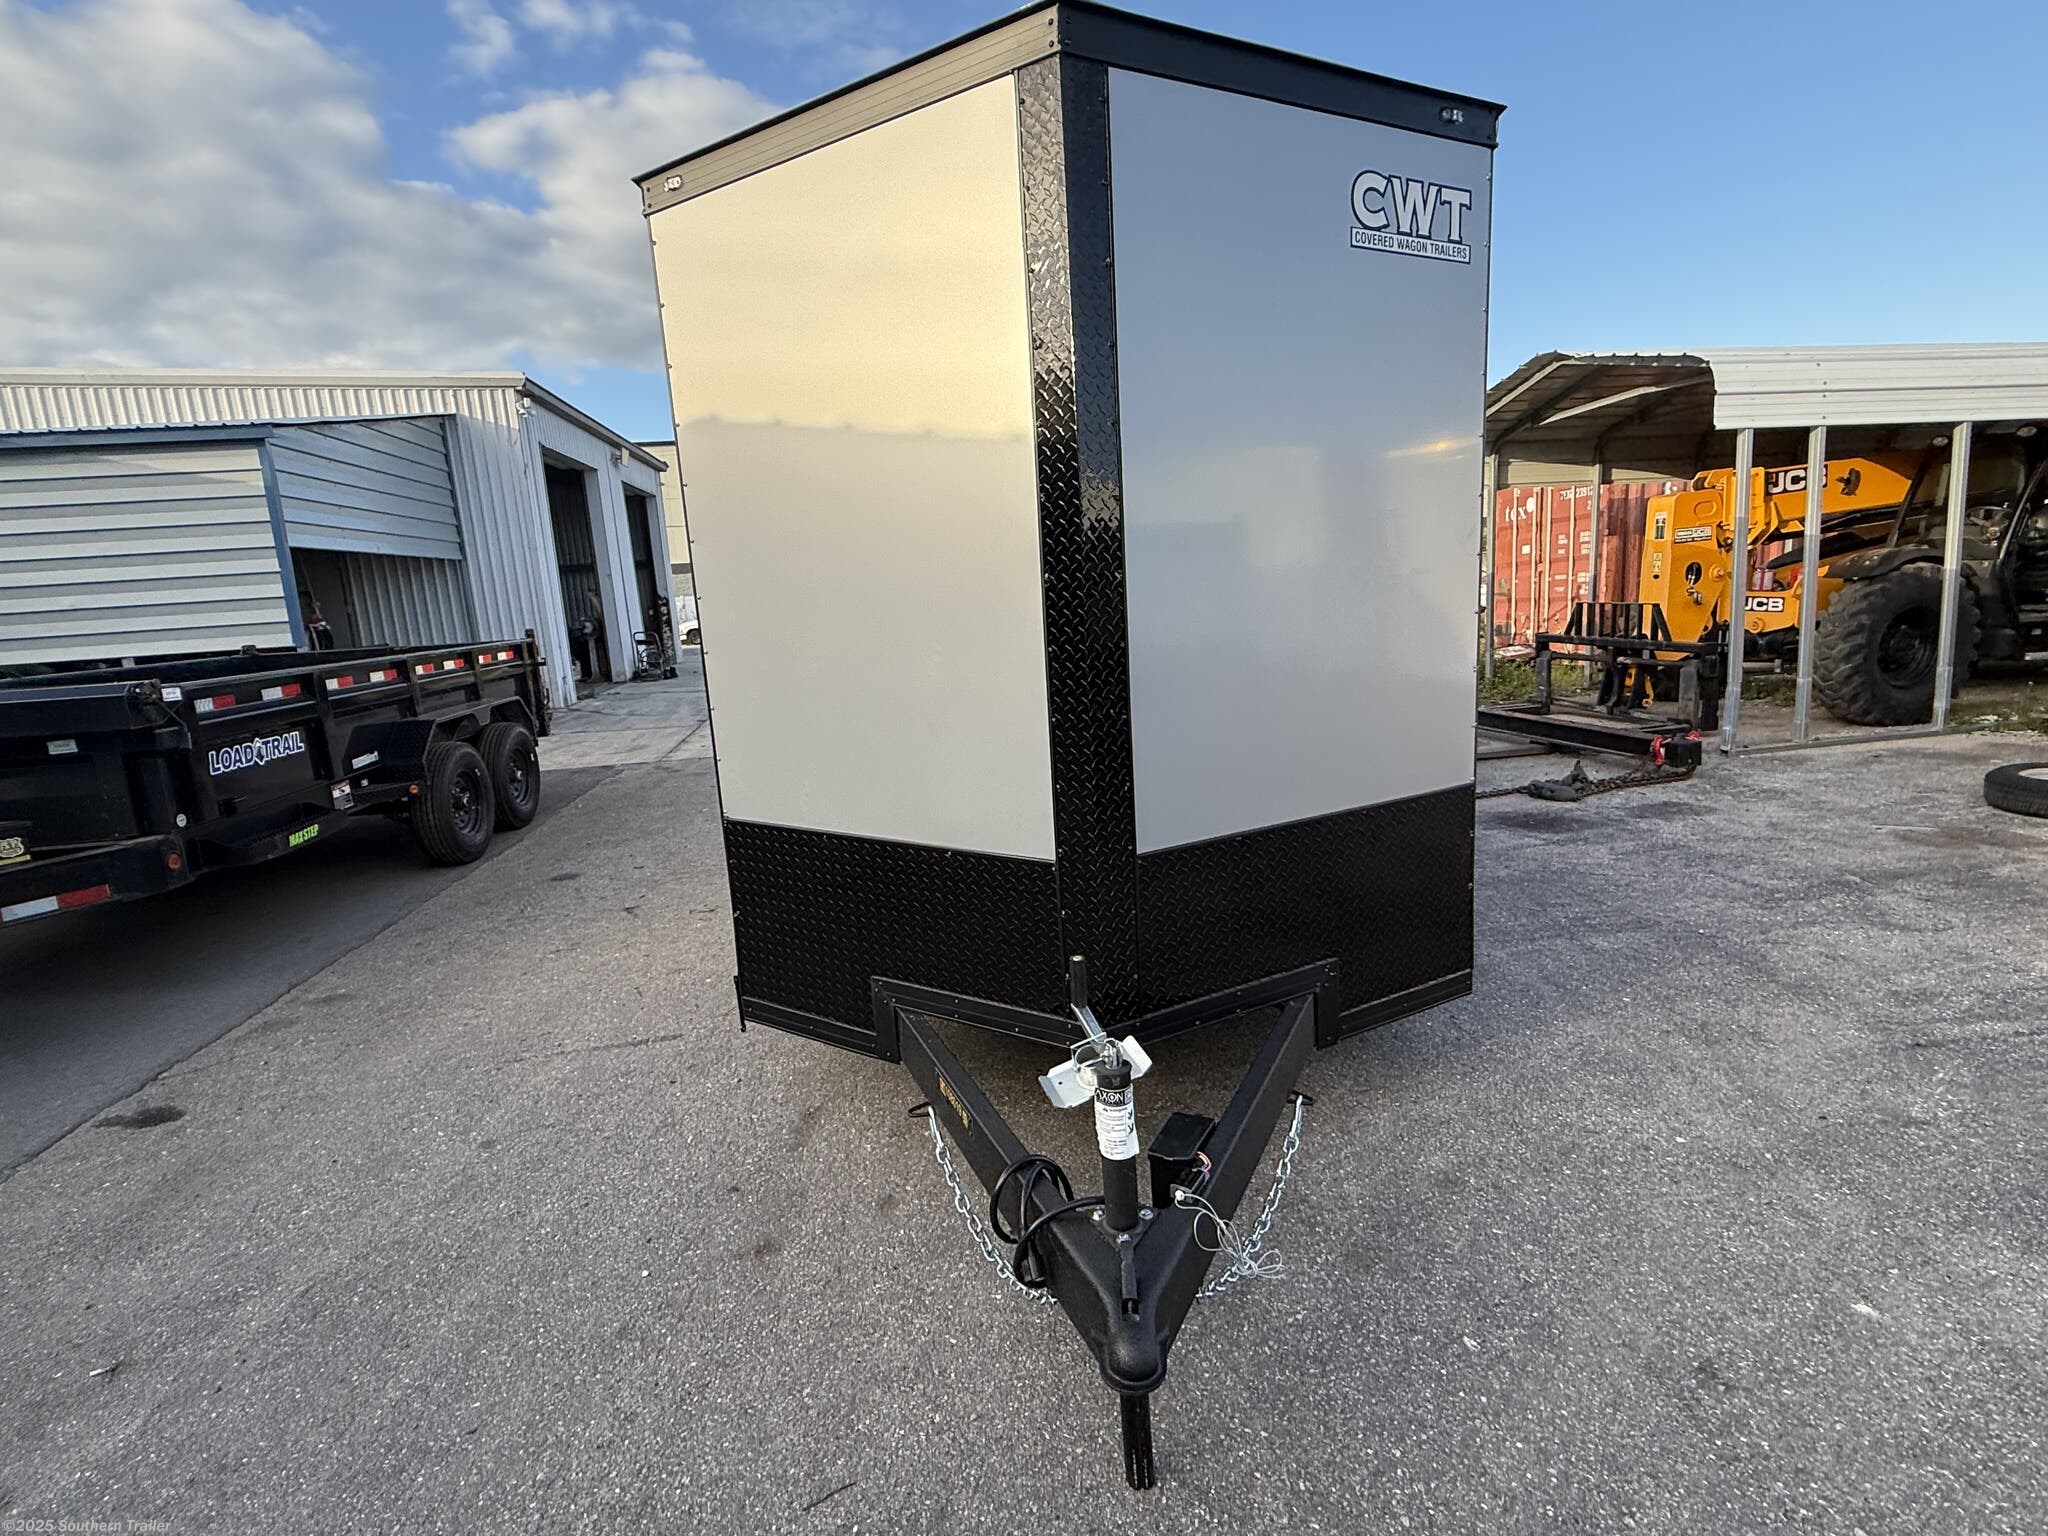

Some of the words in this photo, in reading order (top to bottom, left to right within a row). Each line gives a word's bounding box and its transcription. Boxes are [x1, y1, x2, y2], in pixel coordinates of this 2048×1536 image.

[1351, 170, 1472, 243] CWT
[1354, 231, 1394, 248] COVERED
[1397, 238, 1428, 254] WAGON
[1430, 243, 1467, 260] TRAILERS
[209, 743, 254, 775] LOAD
[261, 731, 304, 760] TRAIL
